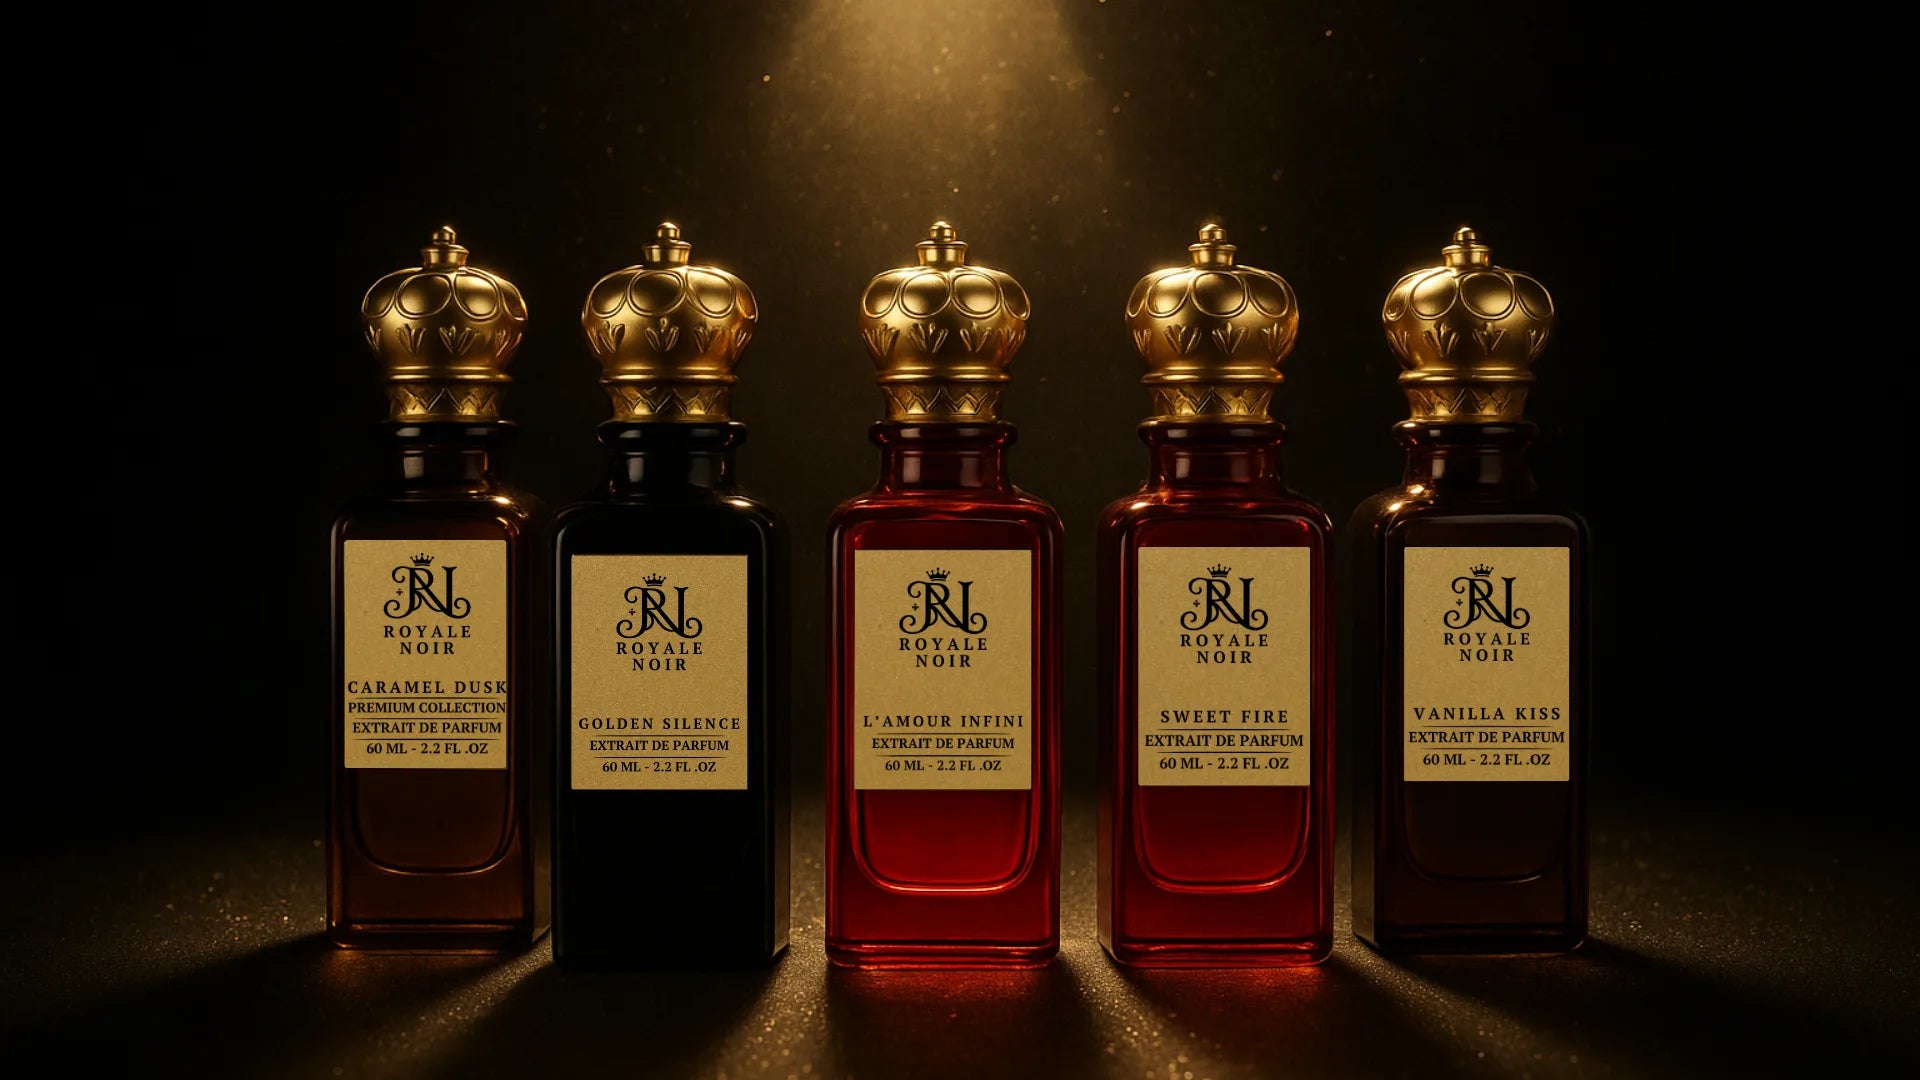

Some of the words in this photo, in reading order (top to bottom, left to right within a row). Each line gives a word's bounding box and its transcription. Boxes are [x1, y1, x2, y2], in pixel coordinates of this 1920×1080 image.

[383, 624, 471, 639] ROYALE
[898, 637, 988, 651] ROYALE
[1179, 633, 1269, 648] ROYALE
[1443, 632, 1531, 646] ROYALE
[399, 641, 455, 655] NOIR
[615, 641, 703, 655] ROYALE
[1459, 648, 1515, 662] NOIR
[631, 657, 687, 672] NOIR
[915, 654, 972, 668] NOIR
[1196, 650, 1253, 665] NOIR
[347, 680, 445, 694] CARAMEL
[453, 680, 507, 694] DUSK
[347, 701, 416, 714] PREMIUM
[418, 701, 507, 714] COLLECTION
[1412, 706, 1505, 721] VANILLA
[1514, 706, 1561, 721] KISS
[578, 717, 654, 730] GOLDEN
[662, 717, 741, 730] SILENCE
[960, 714, 1024, 728] INFINI
[1160, 709, 1232, 724] SWEET
[1241, 709, 1288, 724] FIRE
[352, 721, 416, 734] EXTRAIT
[419, 721, 438, 734] DE
[441, 721, 502, 734] PARFUM
[871, 737, 933, 749] EXTRAIT
[935, 737, 954, 749] DE
[956, 737, 1015, 749] PARFUM
[1144, 734, 1213, 747] EXTRAIT
[1215, 734, 1236, 747] DE
[1239, 734, 1304, 747] PARFUM
[1408, 730, 1475, 744] EXTRAIT
[1477, 730, 1498, 744] DE
[1501, 730, 1565, 744] PARFUM
[366, 742, 383, 755] 60
[385, 742, 408, 755] ML
[420, 742, 441, 755] 2.2
[444, 742, 462, 755] FL
[589, 739, 649, 751] EXTRAIT
[651, 739, 670, 751] DE
[672, 739, 730, 751] PARFUM
[884, 759, 901, 772] 60
[903, 759, 925, 772] ML
[936, 759, 956, 772] 2.2
[959, 759, 976, 772] FL
[1159, 756, 1177, 770] 60
[1180, 756, 1204, 770] ML
[1217, 756, 1239, 770] 2.2
[1242, 756, 1261, 770] FL
[1422, 753, 1441, 766] 60
[1443, 753, 1467, 766] ML
[1479, 753, 1501, 766] 2.2
[1504, 753, 1523, 766] FL
[602, 761, 618, 773] 60
[620, 761, 642, 773] ML
[652, 761, 672, 773] 2.2
[674, 761, 692, 773] FL
